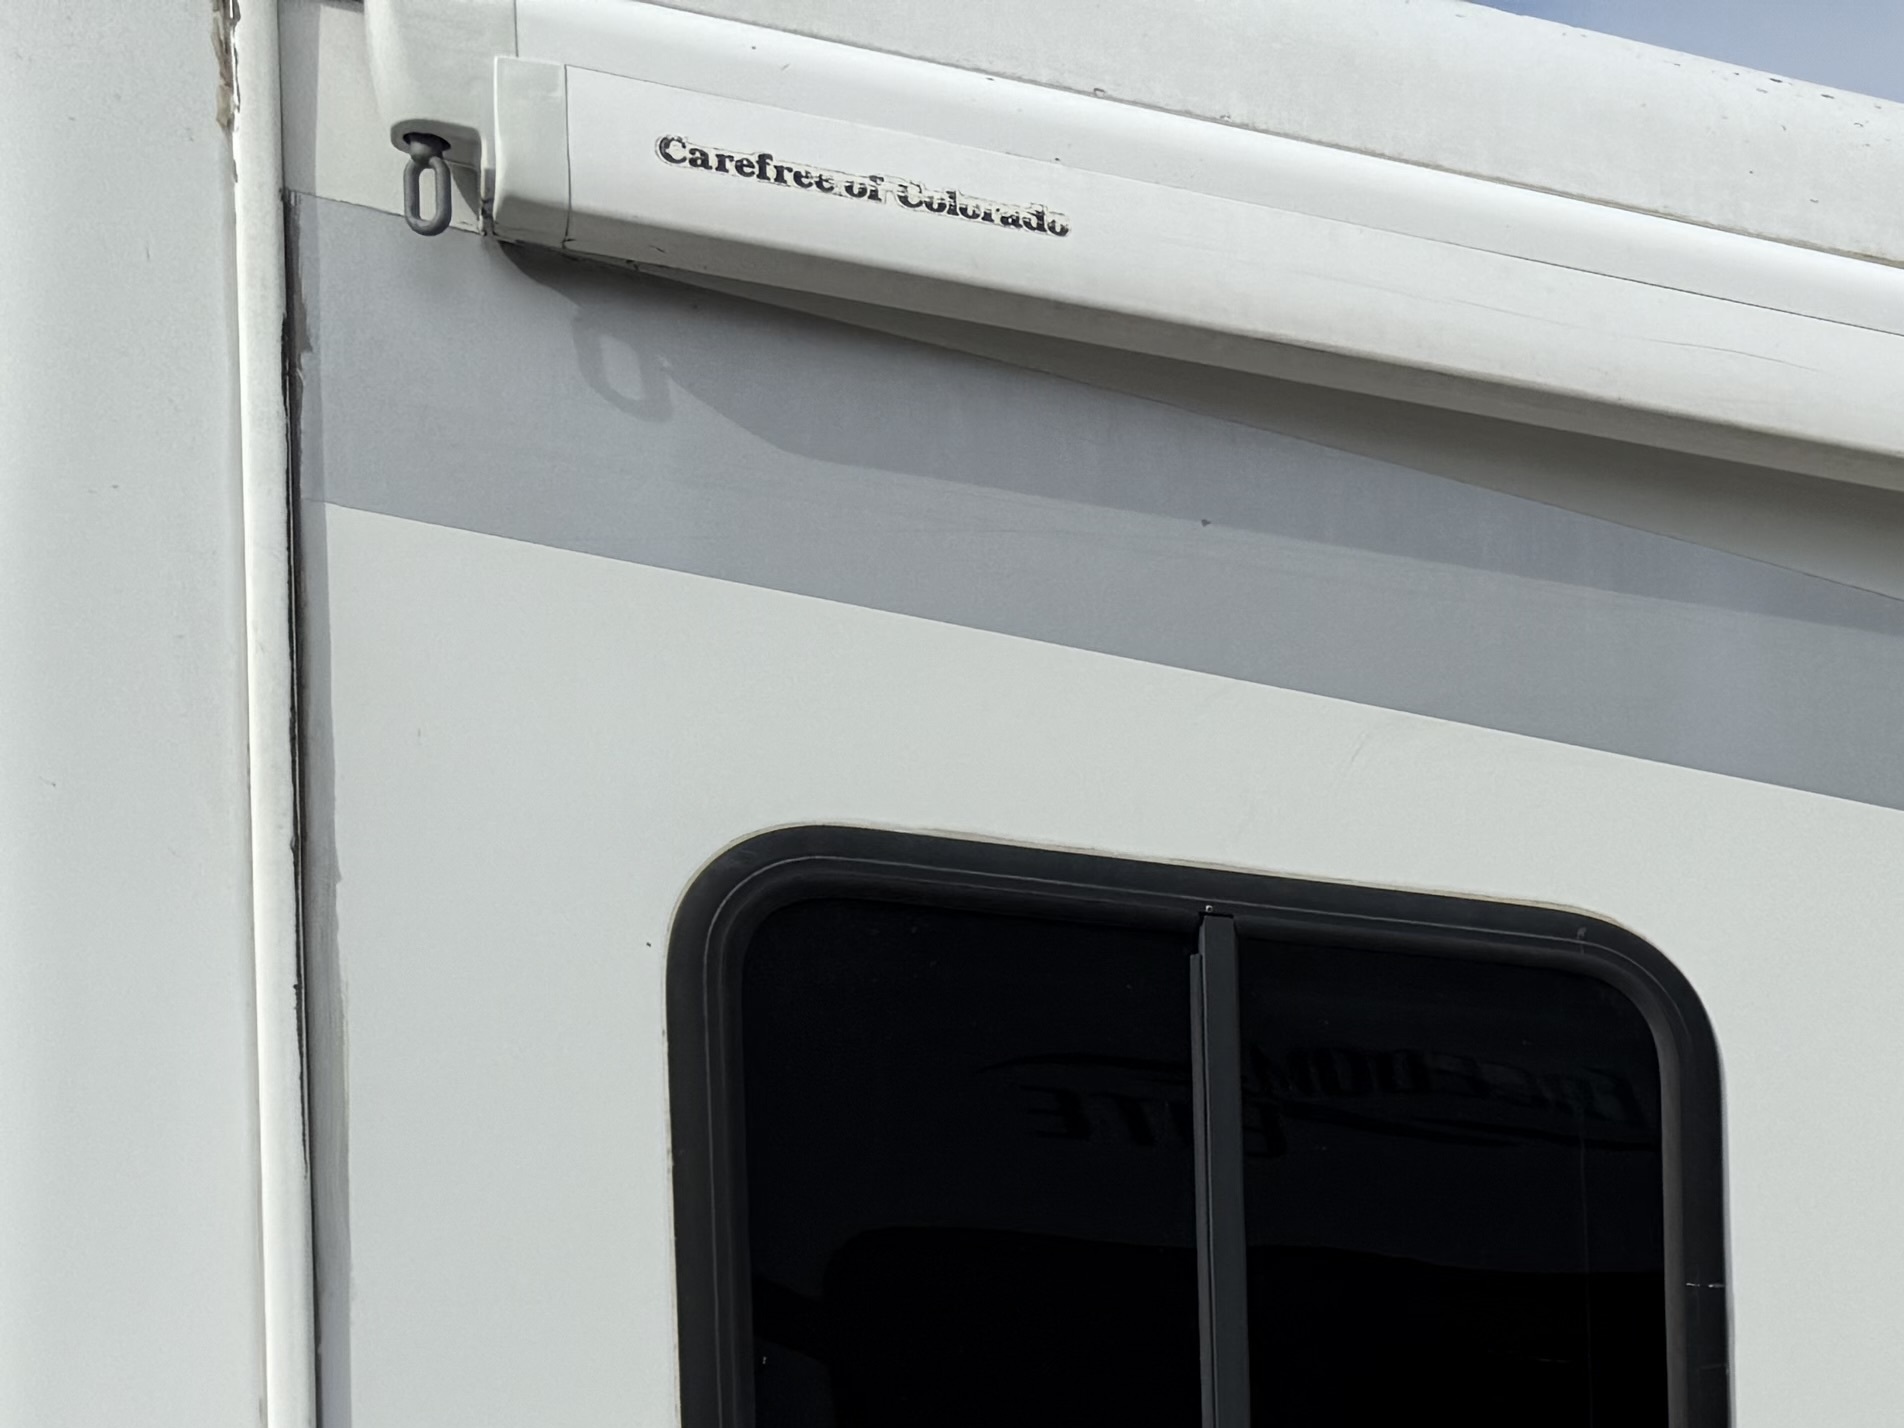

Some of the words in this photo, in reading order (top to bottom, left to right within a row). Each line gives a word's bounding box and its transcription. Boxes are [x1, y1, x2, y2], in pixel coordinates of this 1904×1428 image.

[658, 135, 835, 191] Carefree
[844, 175, 883, 203] of
[899, 182, 1071, 238] Colorado
